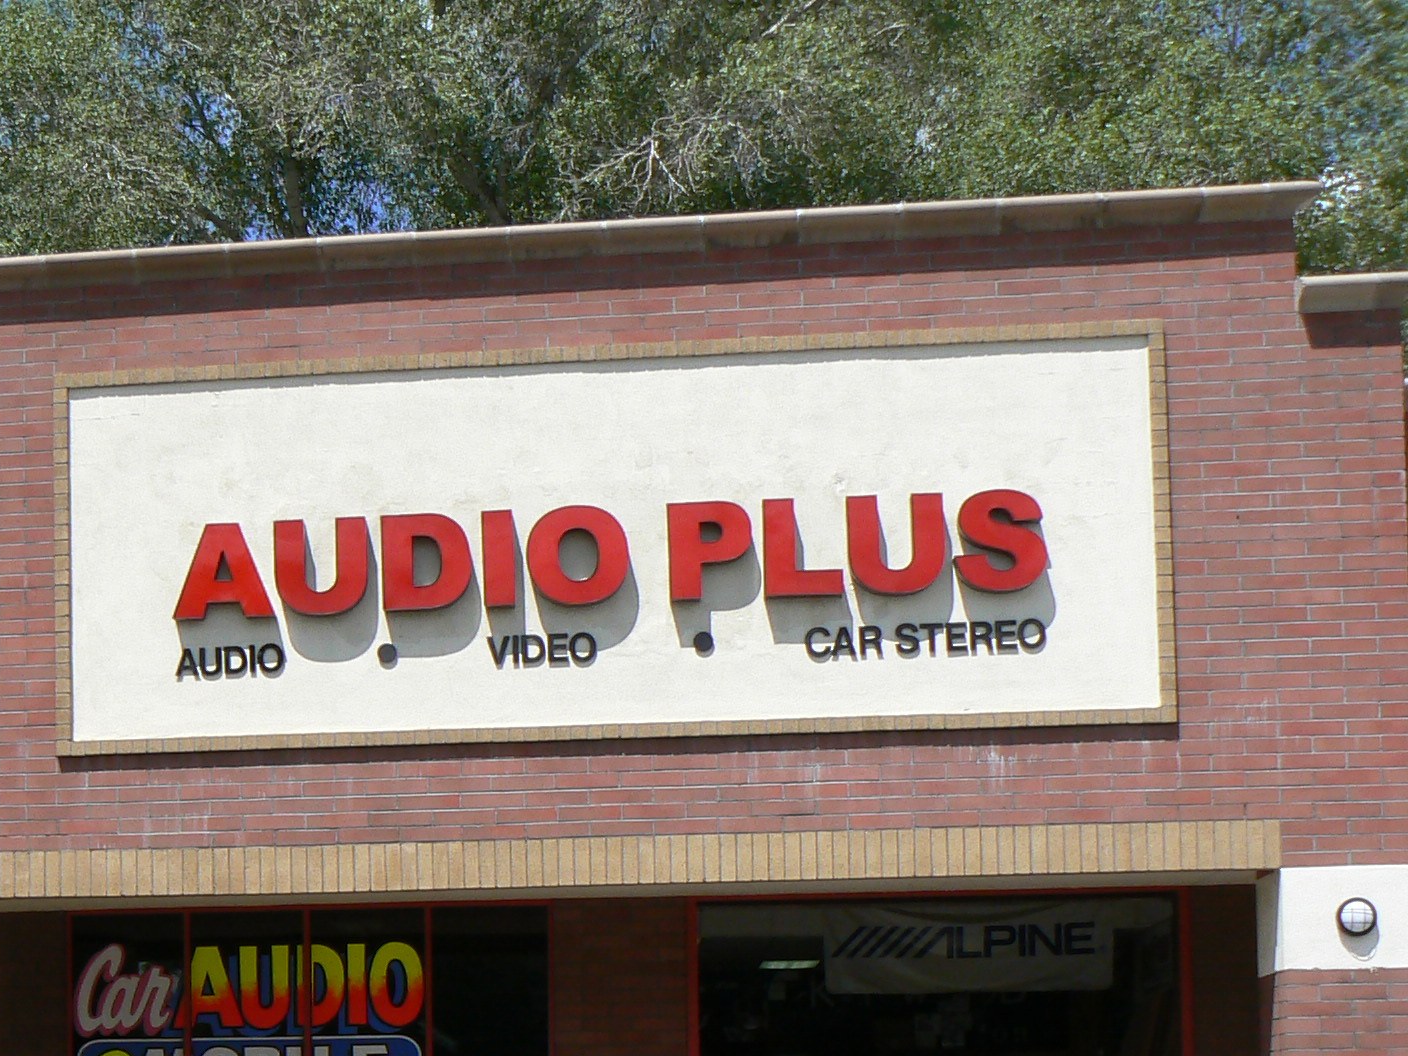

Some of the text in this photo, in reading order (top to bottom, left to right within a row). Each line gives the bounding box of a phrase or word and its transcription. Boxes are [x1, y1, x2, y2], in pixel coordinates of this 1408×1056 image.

[173, 488, 1049, 621] AUDIO PLUS
[486, 631, 596, 669] VIDEO
[805, 617, 1046, 658] CAR STEREO
[176, 641, 285, 679] AUDIO
[832, 921, 1097, 959] ALPINE
[76, 943, 175, 1036] Car
[174, 941, 425, 1030] AUDIO
